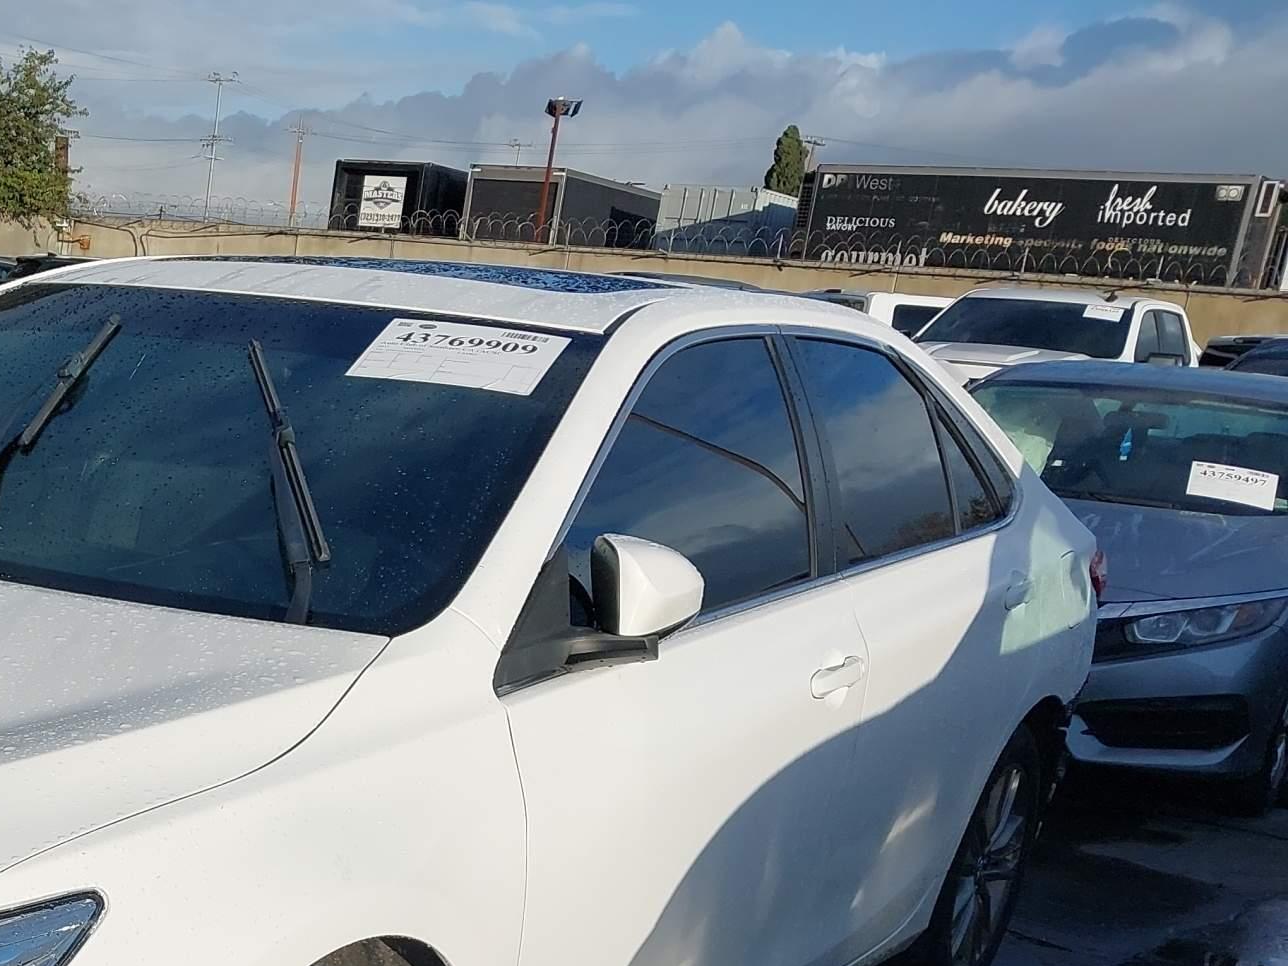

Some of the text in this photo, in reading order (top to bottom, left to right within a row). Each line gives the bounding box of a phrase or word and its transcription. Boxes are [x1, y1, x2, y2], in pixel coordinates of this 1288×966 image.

[855, 175, 892, 190] West
[984, 188, 1065, 228] bakery
[1102, 184, 1157, 223] fresh
[826, 216, 896, 228] DELICIOUS
[1097, 206, 1192, 228] imported
[939, 232, 1013, 247] Marketing
[396, 331, 538, 355] 43769909
